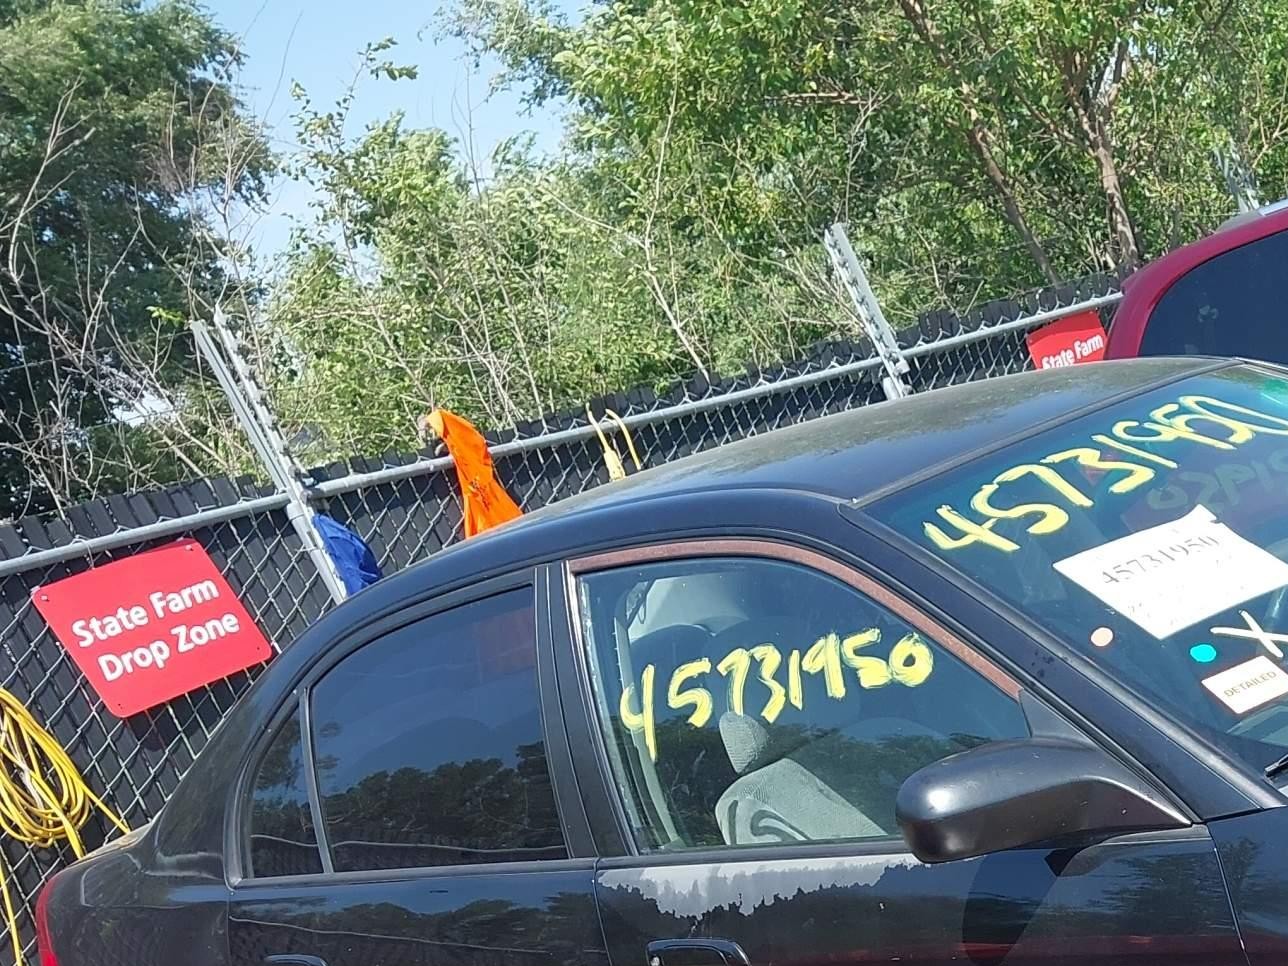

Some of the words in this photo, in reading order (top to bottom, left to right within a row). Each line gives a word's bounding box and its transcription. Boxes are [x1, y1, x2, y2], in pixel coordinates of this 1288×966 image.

[1041, 348, 1075, 369] State
[1073, 334, 1104, 360] Farm
[1102, 535, 1220, 584] 45731950
[72, 605, 148, 647] State
[149, 580, 220, 618] Farm
[98, 640, 170, 681] Drop
[170, 613, 240, 653] Zone
[618, 627, 934, 762] 45731950
[1223, 671, 1277, 697] DETAILED
